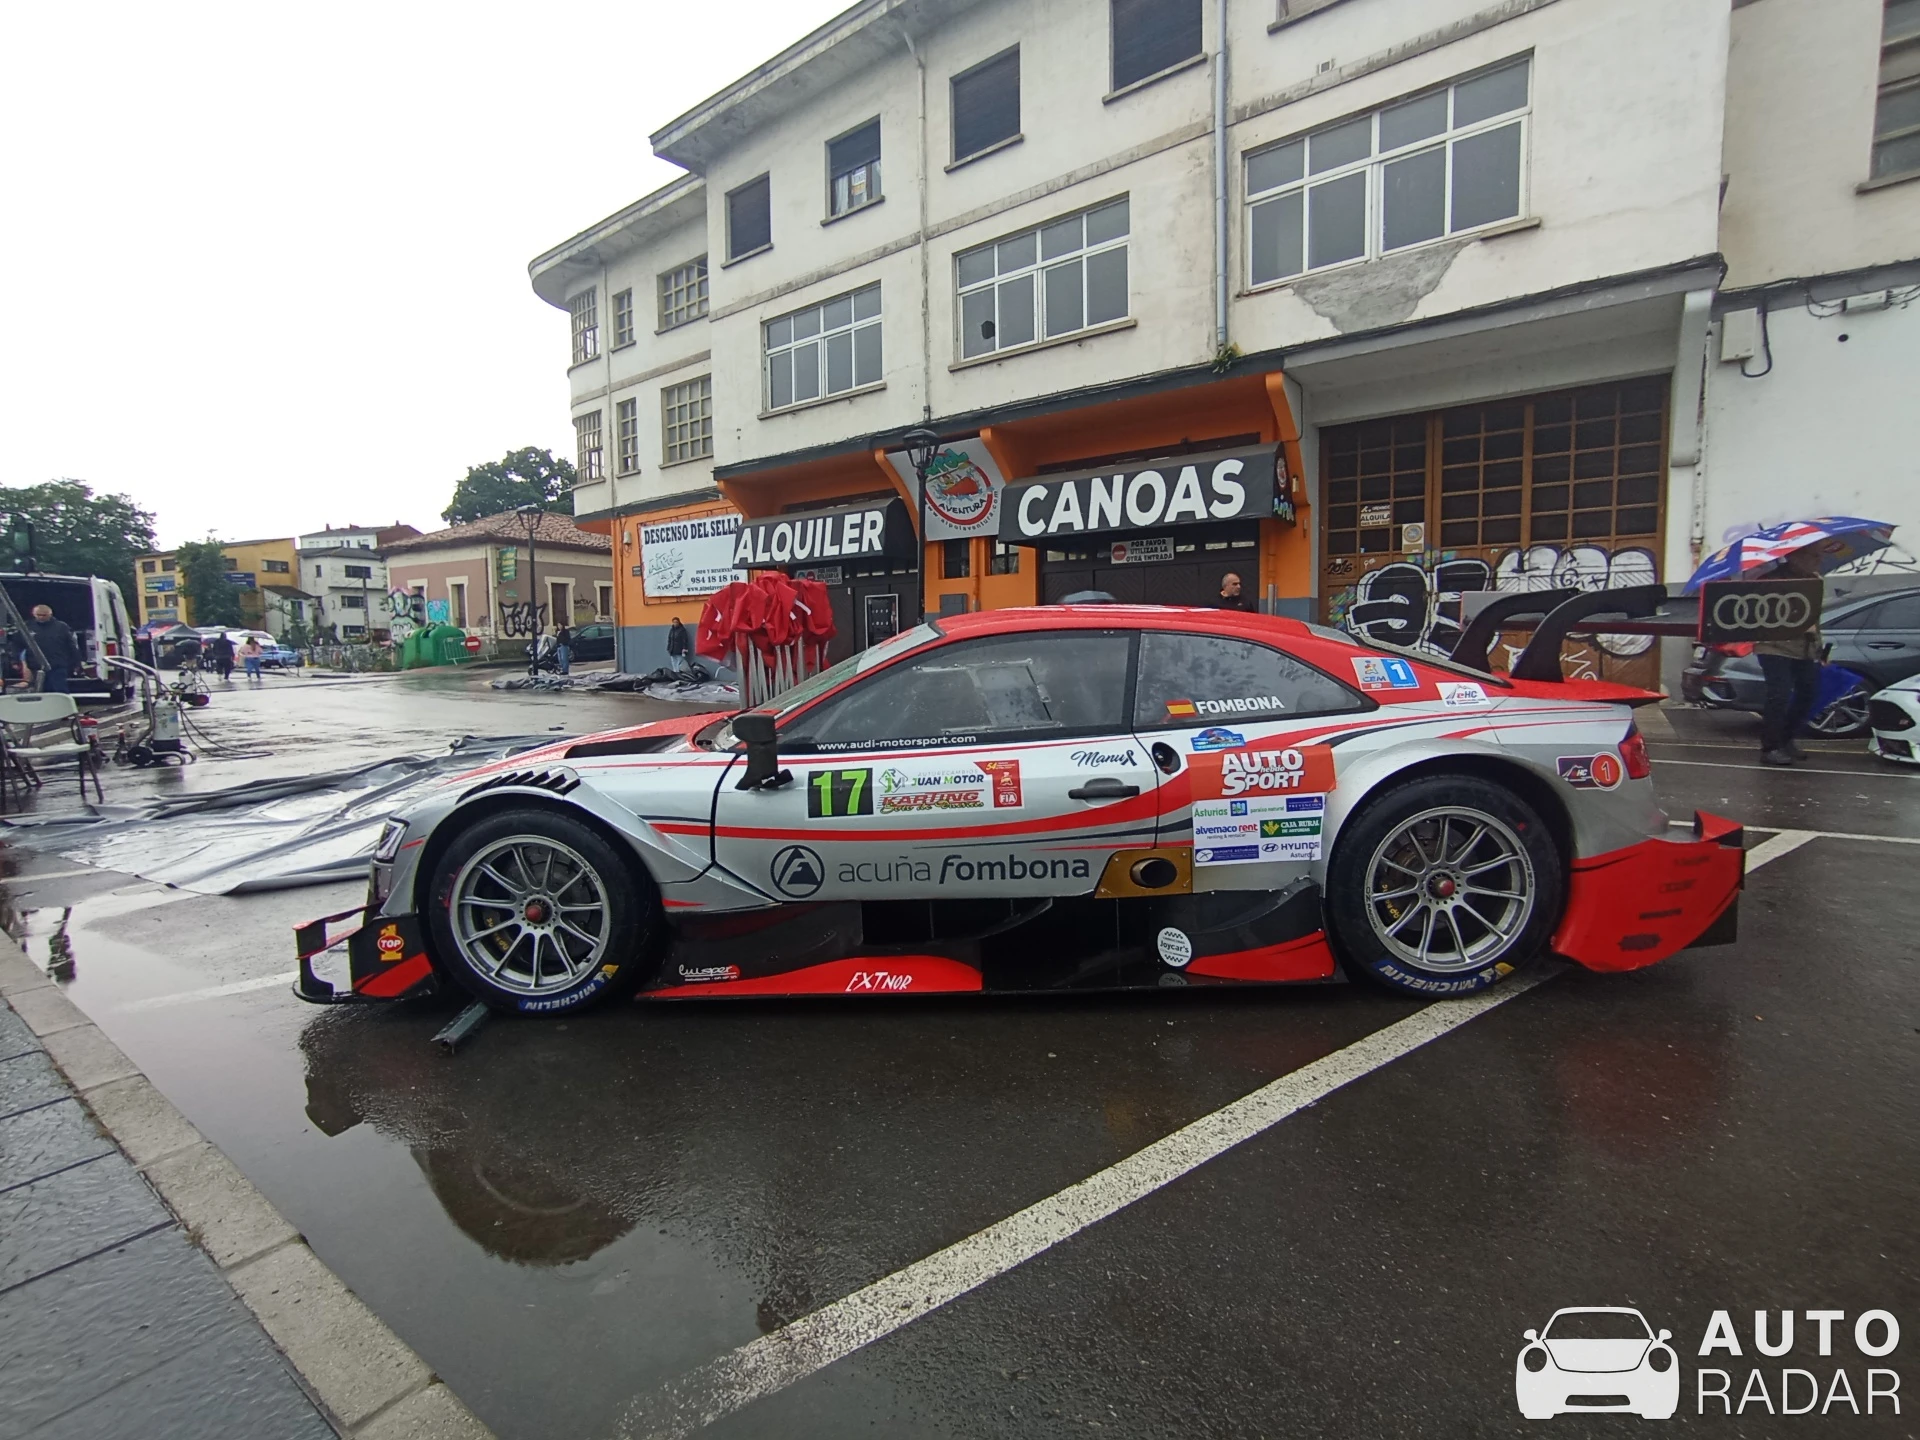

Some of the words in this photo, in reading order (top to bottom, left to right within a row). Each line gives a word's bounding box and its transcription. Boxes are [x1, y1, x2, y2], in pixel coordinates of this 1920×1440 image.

[938, 498, 987, 514] AVENTURA
[1018, 459, 1246, 537] CANOAS
[644, 524, 689, 545] DESCENSO
[690, 521, 709, 540] DEL
[733, 510, 884, 563] ALQUILER
[1145, 538, 1167, 546] FAVOR
[1144, 553, 1173, 561] ENTRADA
[690, 576, 706, 584] 984
[708, 575, 717, 583] 18
[718, 574, 728, 583] 18
[730, 573, 740, 582] 16
[1390, 663, 1407, 680] 1
[1195, 695, 1285, 715] FOMBONA
[817, 734, 977, 751] www.audi-motorsport.com
[986, 762, 997, 771] 54
[1221, 748, 1303, 775] AUTO
[1260, 764, 1285, 773] hebdo
[1601, 760, 1611, 782] 1
[911, 777, 941, 786] JUAN
[943, 774, 985, 784] MOTOR
[1221, 770, 1305, 796] SPORT
[812, 769, 868, 816] 17
[882, 791, 980, 805] KARTING
[1000, 794, 1015, 803] FIA
[1194, 807, 1228, 817] Asturias
[1195, 825, 1238, 835] alvemaco
[1239, 823, 1258, 832] rent
[838, 855, 931, 883] acuña
[938, 854, 1090, 885] fombona
[380, 939, 402, 948] TOP
[1159, 939, 1190, 953] Joycar's
[844, 971, 913, 992] EXTNOR
[1379, 964, 1478, 992] MICHELIN
[524, 982, 597, 1010] MICHELIN
